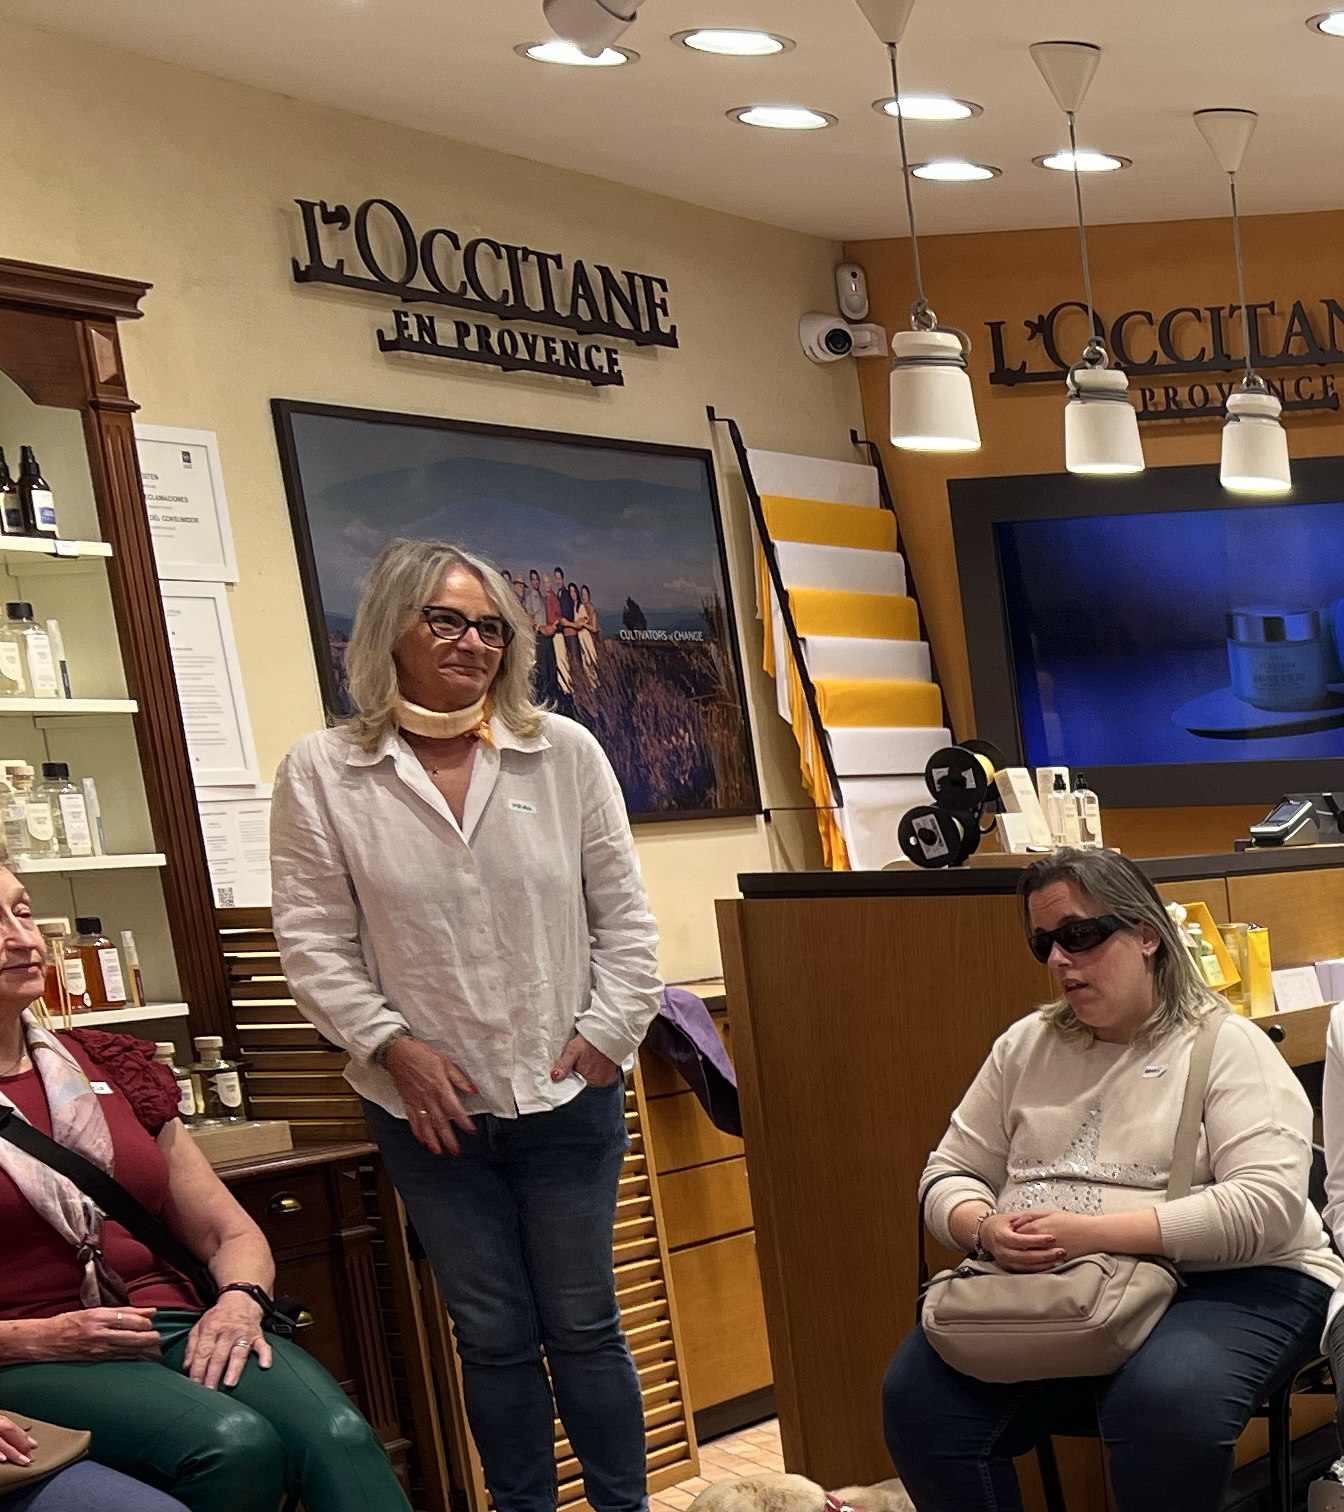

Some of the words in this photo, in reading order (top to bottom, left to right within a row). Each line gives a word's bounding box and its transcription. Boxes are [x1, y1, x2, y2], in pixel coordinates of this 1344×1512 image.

[392, 310, 437, 345] EN
[453, 320, 623, 381] PROVENCE
[1140, 374, 1338, 412] PROVNCE
[620, 629, 669, 641] CULTIVATORS
[674, 630, 704, 641] CHANGE
